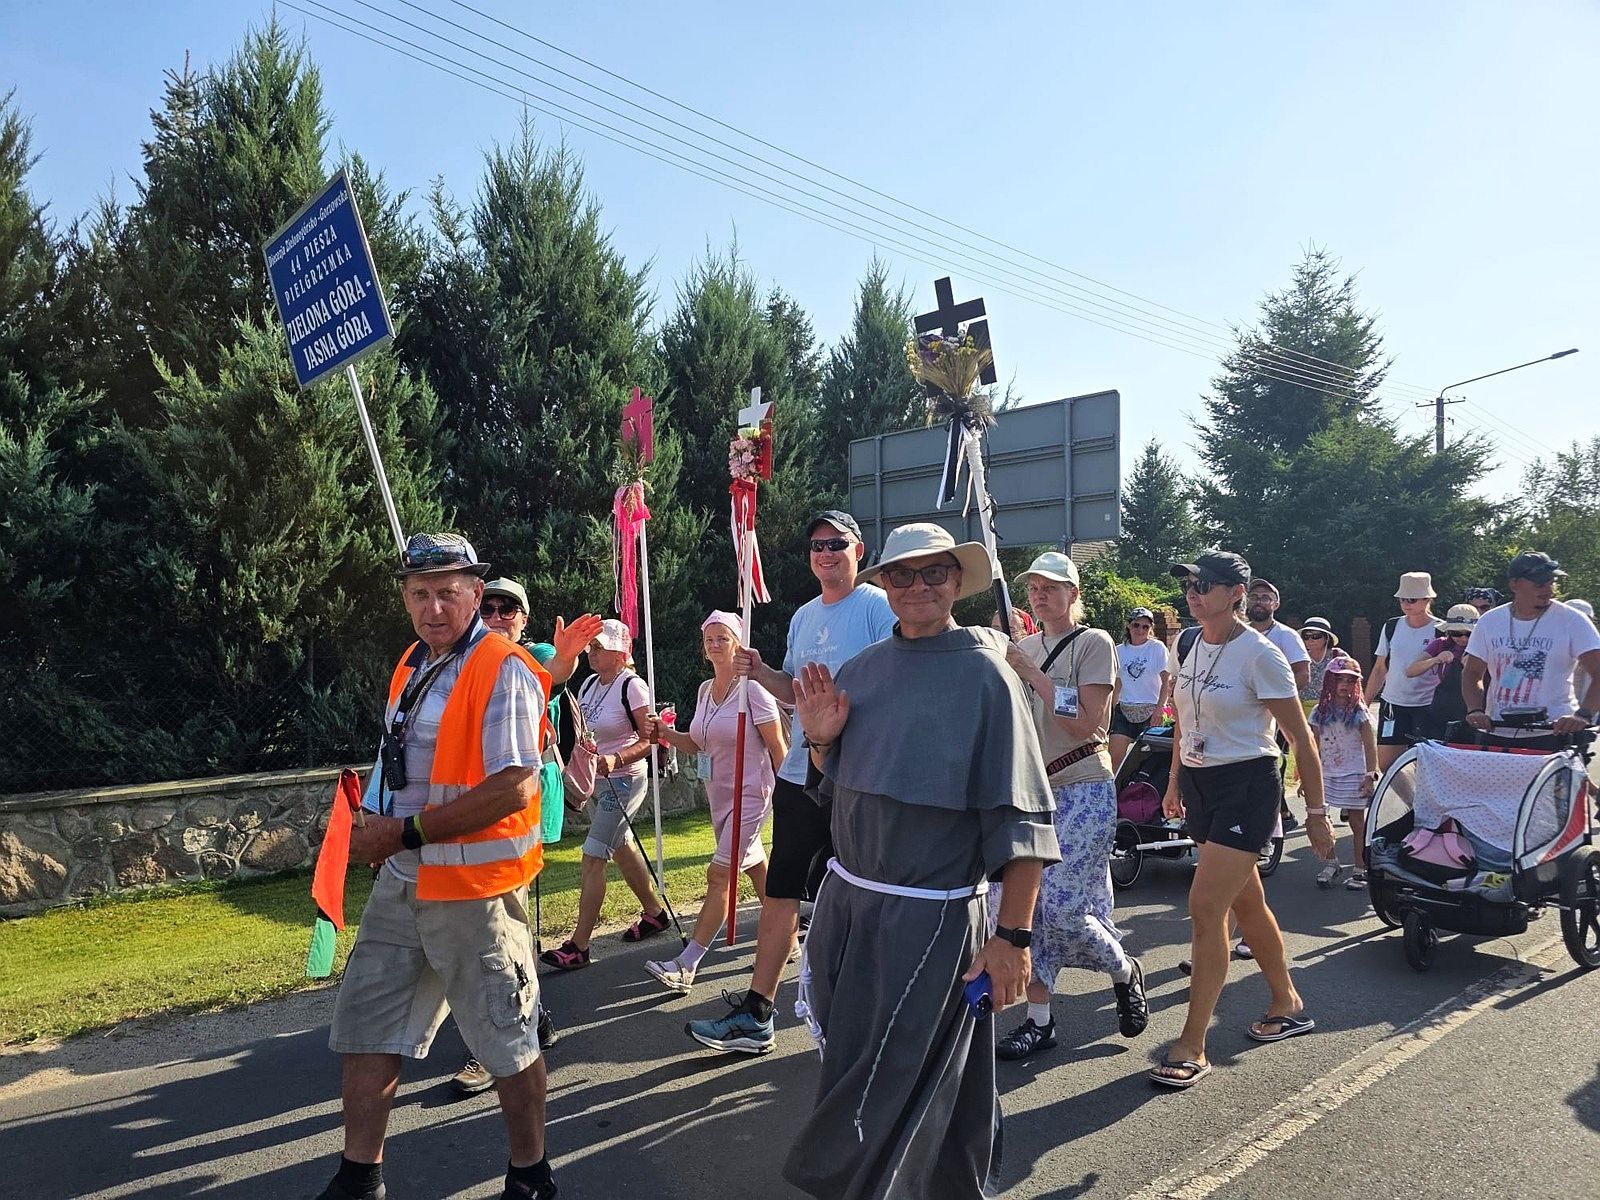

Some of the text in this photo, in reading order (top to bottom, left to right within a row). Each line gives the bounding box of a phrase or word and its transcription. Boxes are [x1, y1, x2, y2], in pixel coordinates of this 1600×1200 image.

[284, 243, 352, 306] PIELGRZYMKA
[291, 224, 337, 275] 44 PIESZA
[286, 298, 331, 345] ZIELONA
[329, 274, 366, 315] GÓRA
[303, 311, 373, 371] JASNA GÓRA
